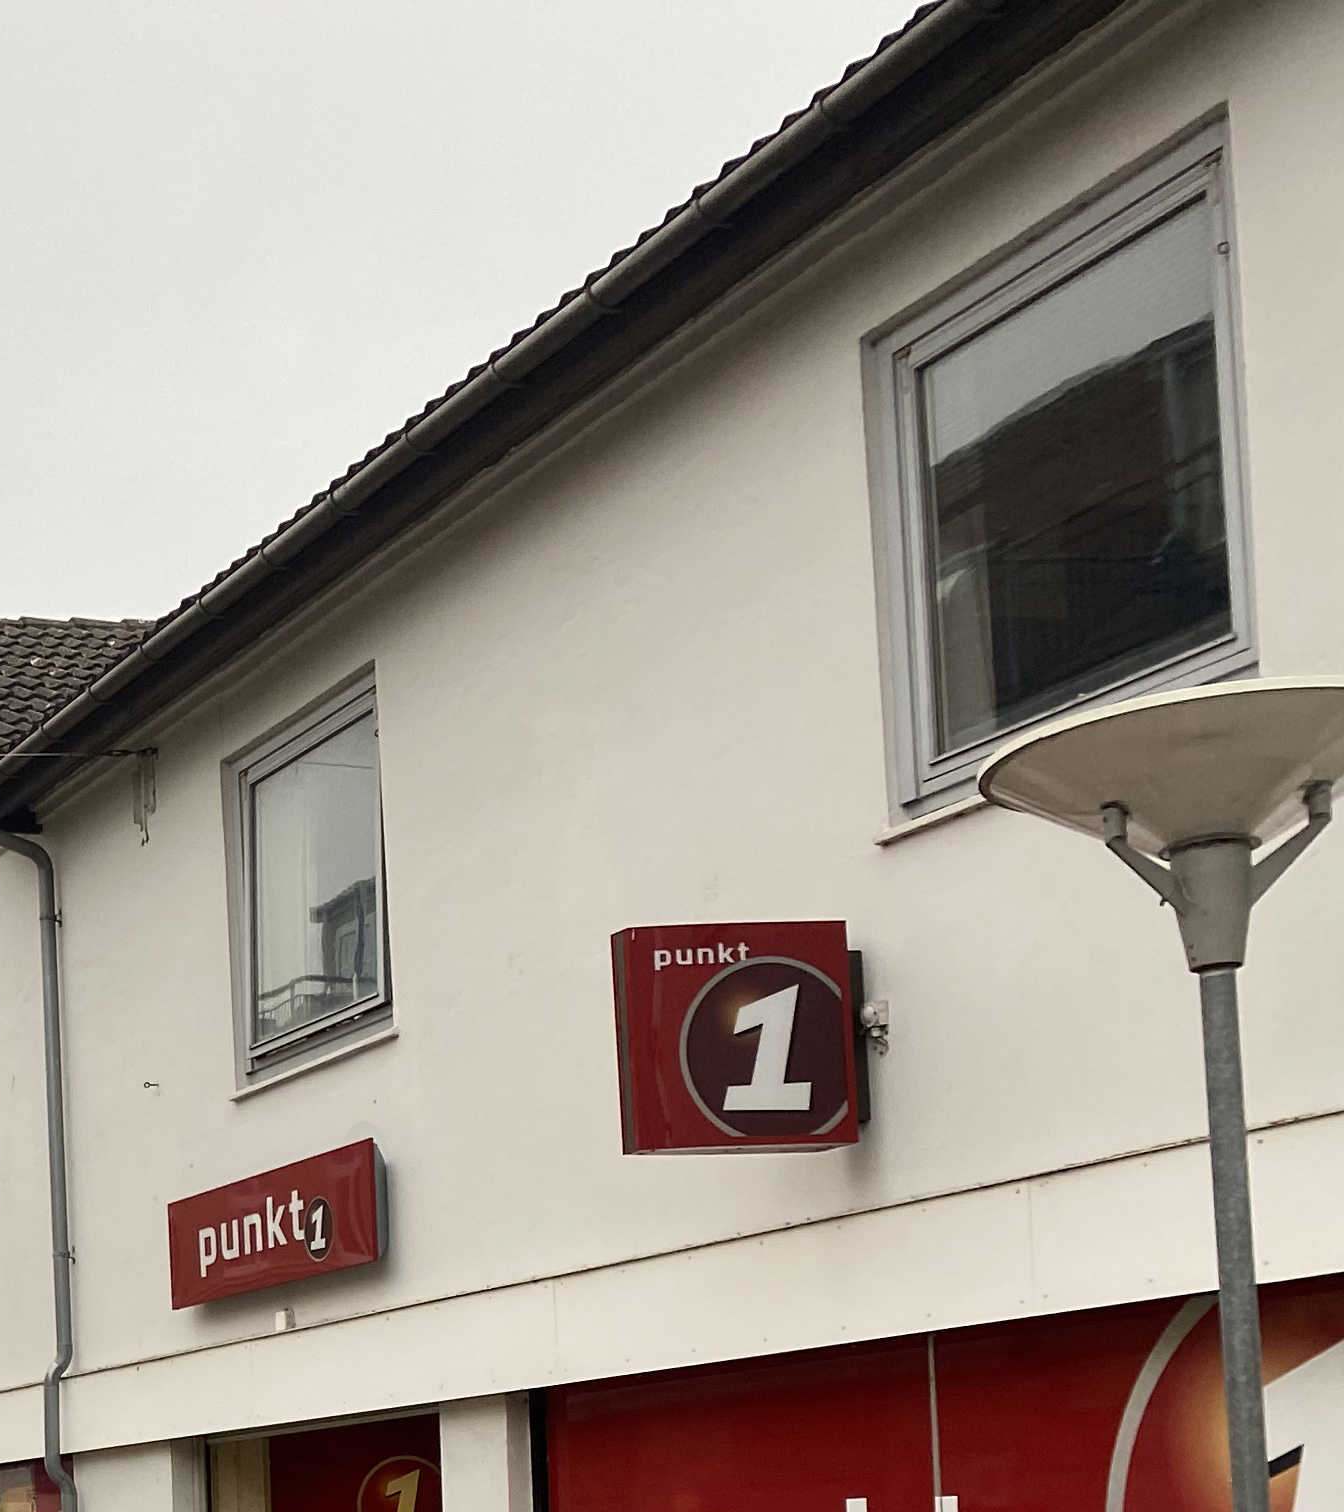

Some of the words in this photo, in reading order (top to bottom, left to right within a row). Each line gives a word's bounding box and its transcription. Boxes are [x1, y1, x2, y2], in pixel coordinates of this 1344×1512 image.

[653, 942, 750, 971] punkt
[723, 983, 812, 1110] 1
[198, 1189, 305, 1278] punkt
[310, 1204, 326, 1251] 1
